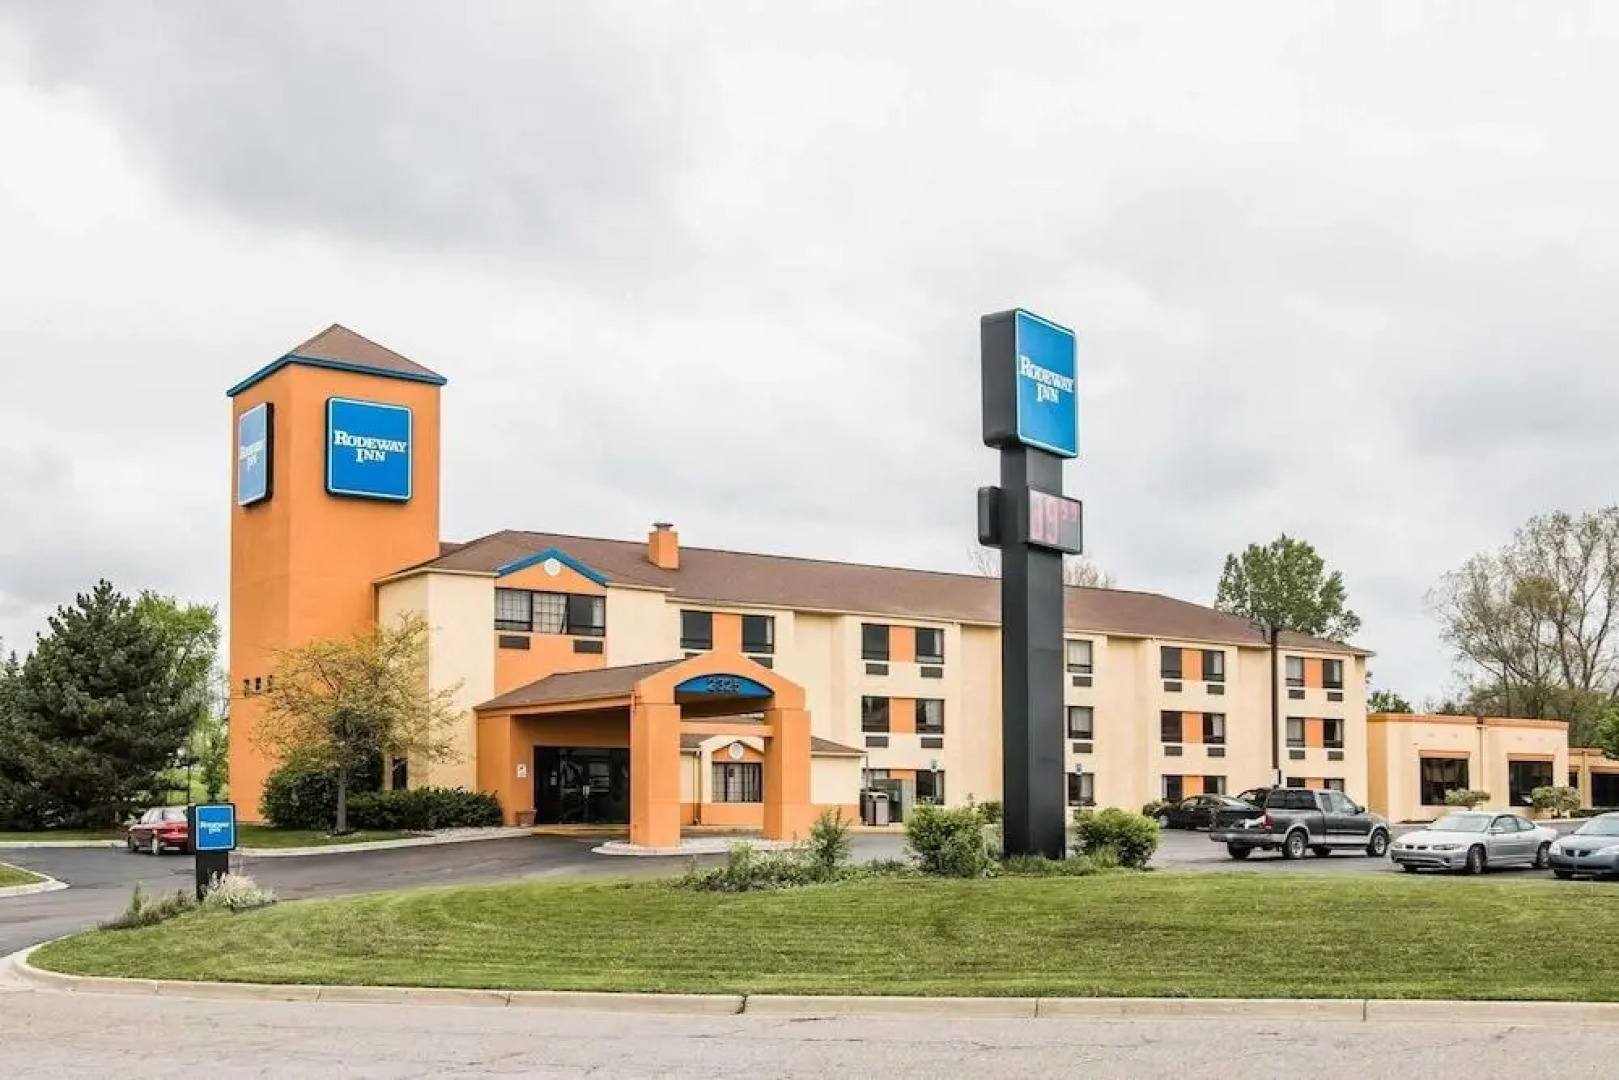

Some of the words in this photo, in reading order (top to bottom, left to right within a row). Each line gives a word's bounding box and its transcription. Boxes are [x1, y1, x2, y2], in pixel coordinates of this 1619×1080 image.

[1019, 355, 1074, 392] RODEWAY
[1036, 383, 1059, 403] INN
[334, 430, 407, 453] RODEWAY
[356, 449, 386, 463] INN
